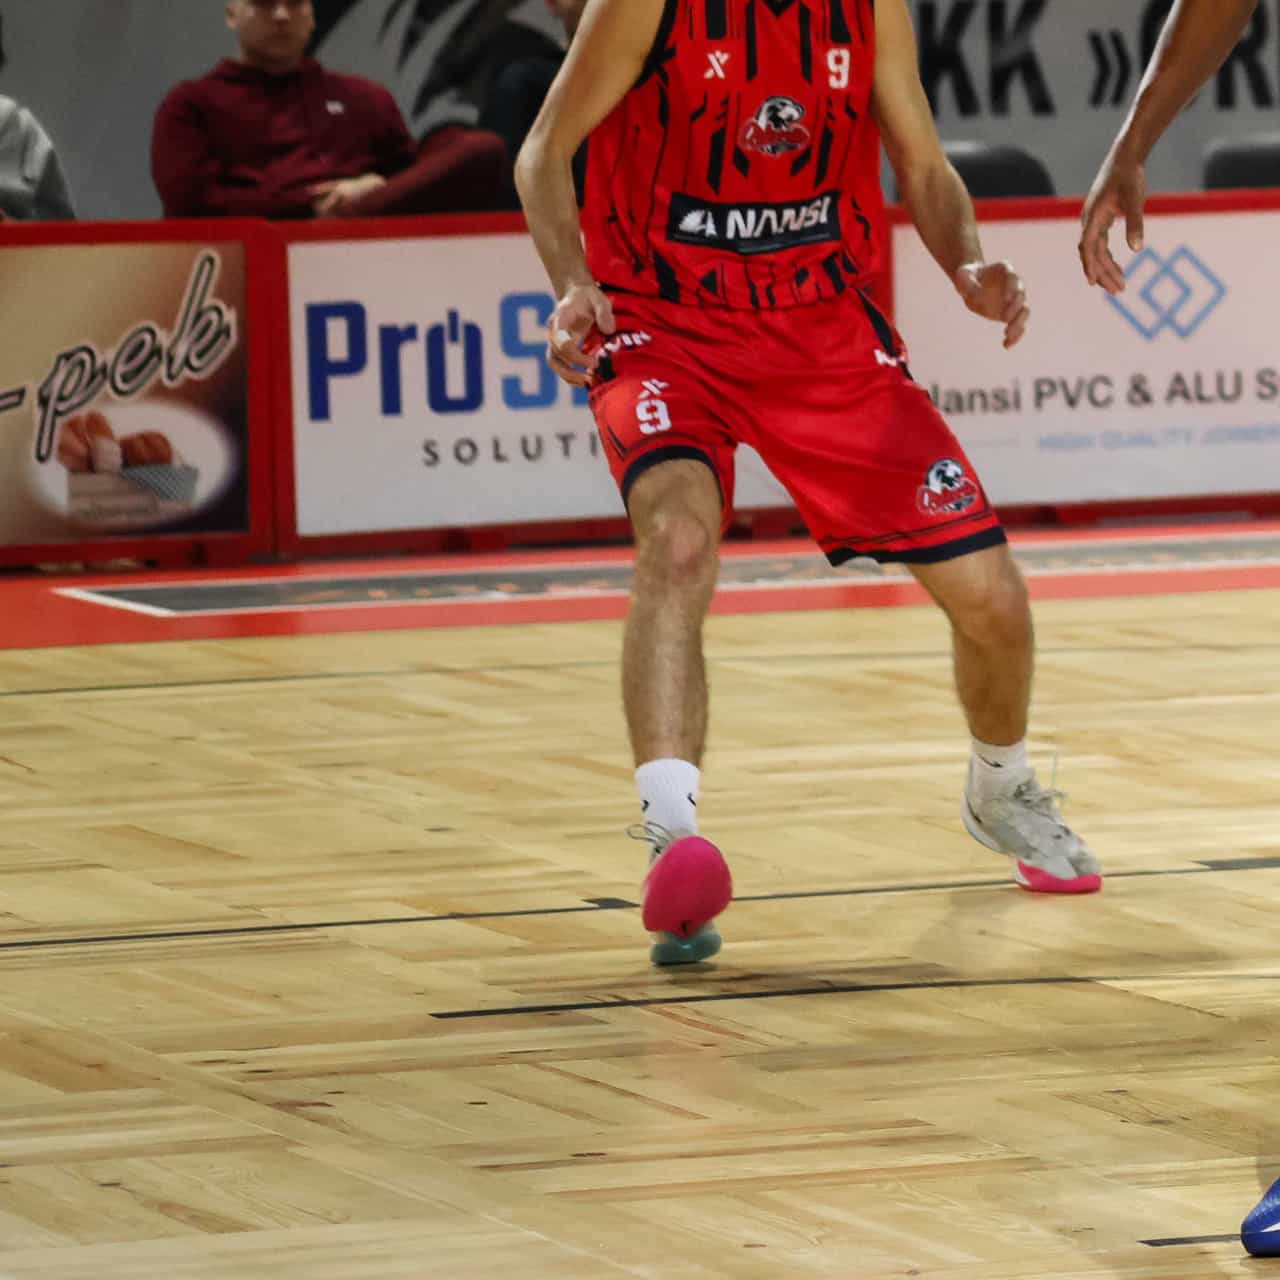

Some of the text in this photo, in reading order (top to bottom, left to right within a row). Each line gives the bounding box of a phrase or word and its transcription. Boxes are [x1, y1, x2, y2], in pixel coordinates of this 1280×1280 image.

[826, 48, 850, 89] 9
[726, 196, 831, 239] NANSI
[306, 291, 592, 422] ProS
[1034, 376, 1114, 409] PVC
[1126, 373, 1154, 405] &
[1166, 369, 1243, 403] ALU
[636, 400, 672, 434] 9
